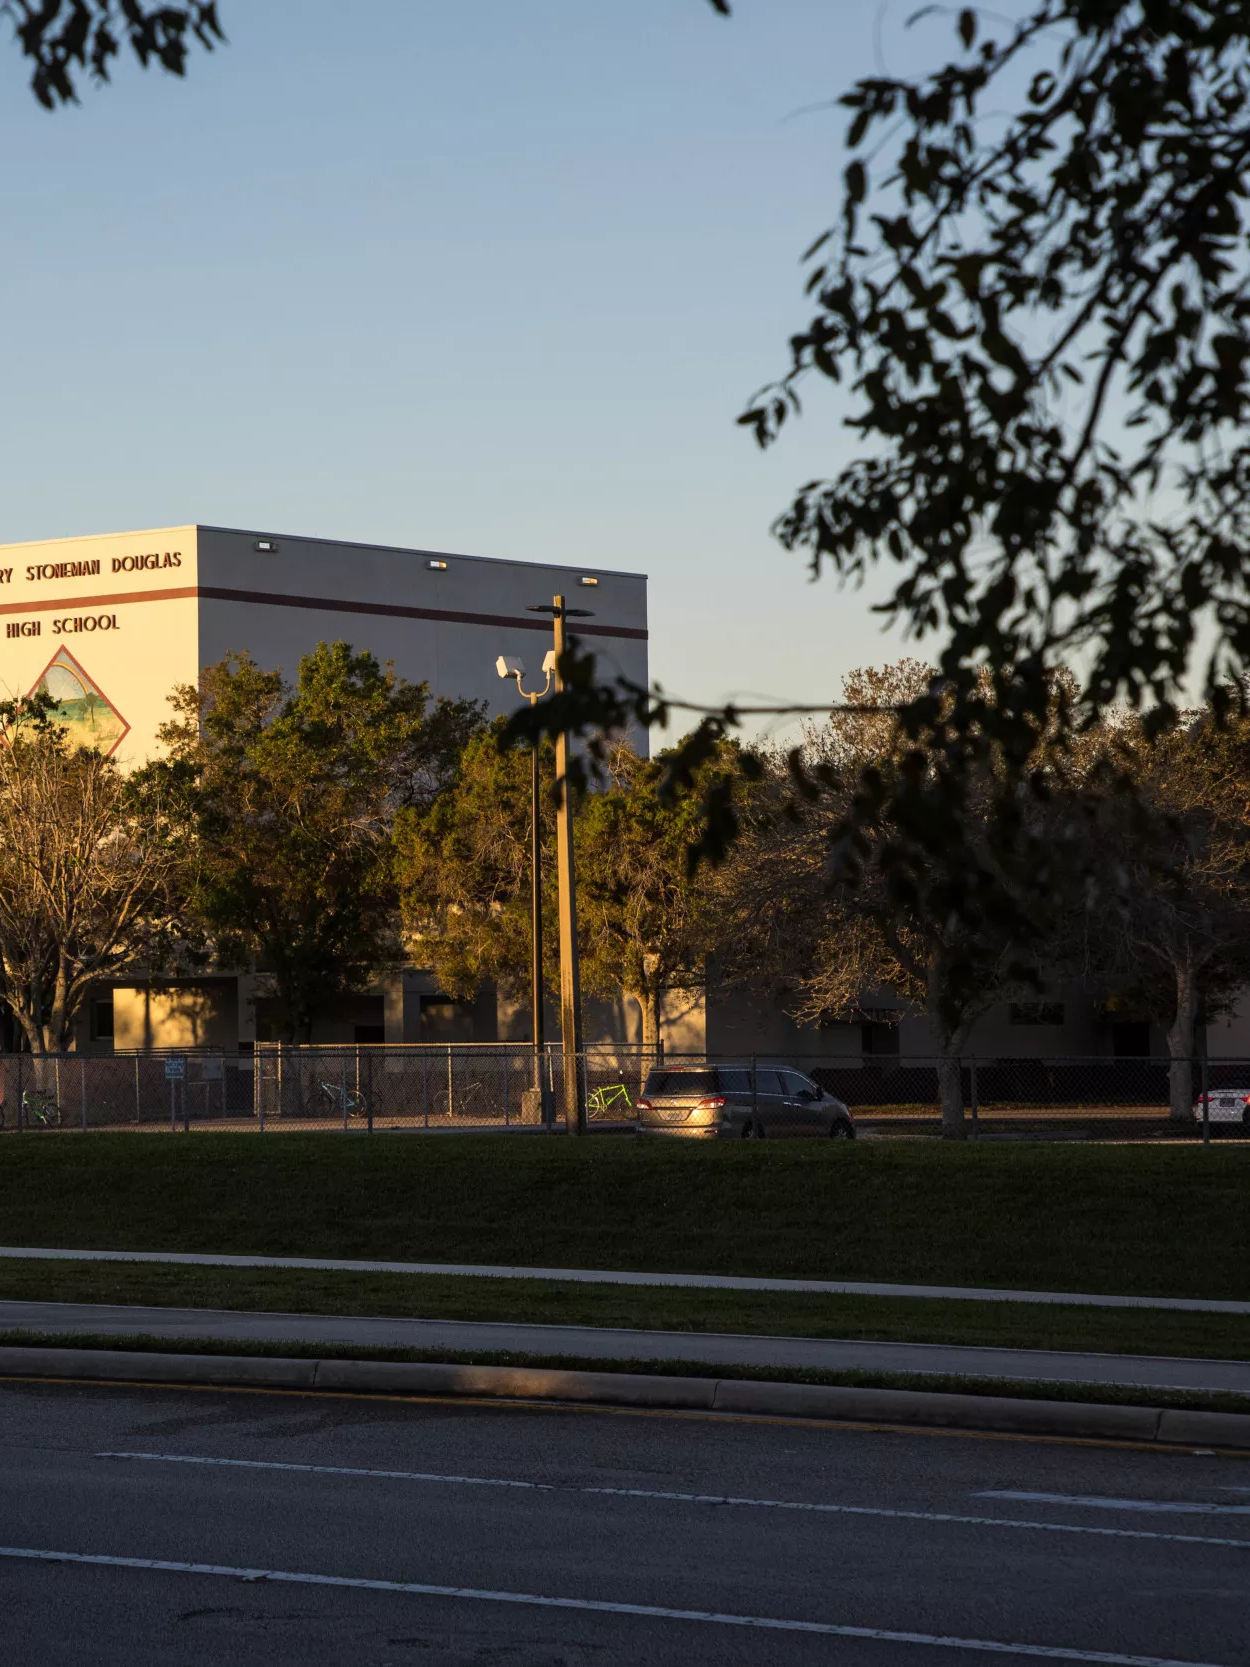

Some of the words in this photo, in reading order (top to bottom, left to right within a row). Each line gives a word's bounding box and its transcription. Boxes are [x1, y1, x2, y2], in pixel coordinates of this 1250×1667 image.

[25, 559, 101, 582] STONEMAN
[111, 551, 182, 574] DOUGLAS
[6, 620, 42, 639] HIGH
[52, 614, 120, 635] SCHOOL
